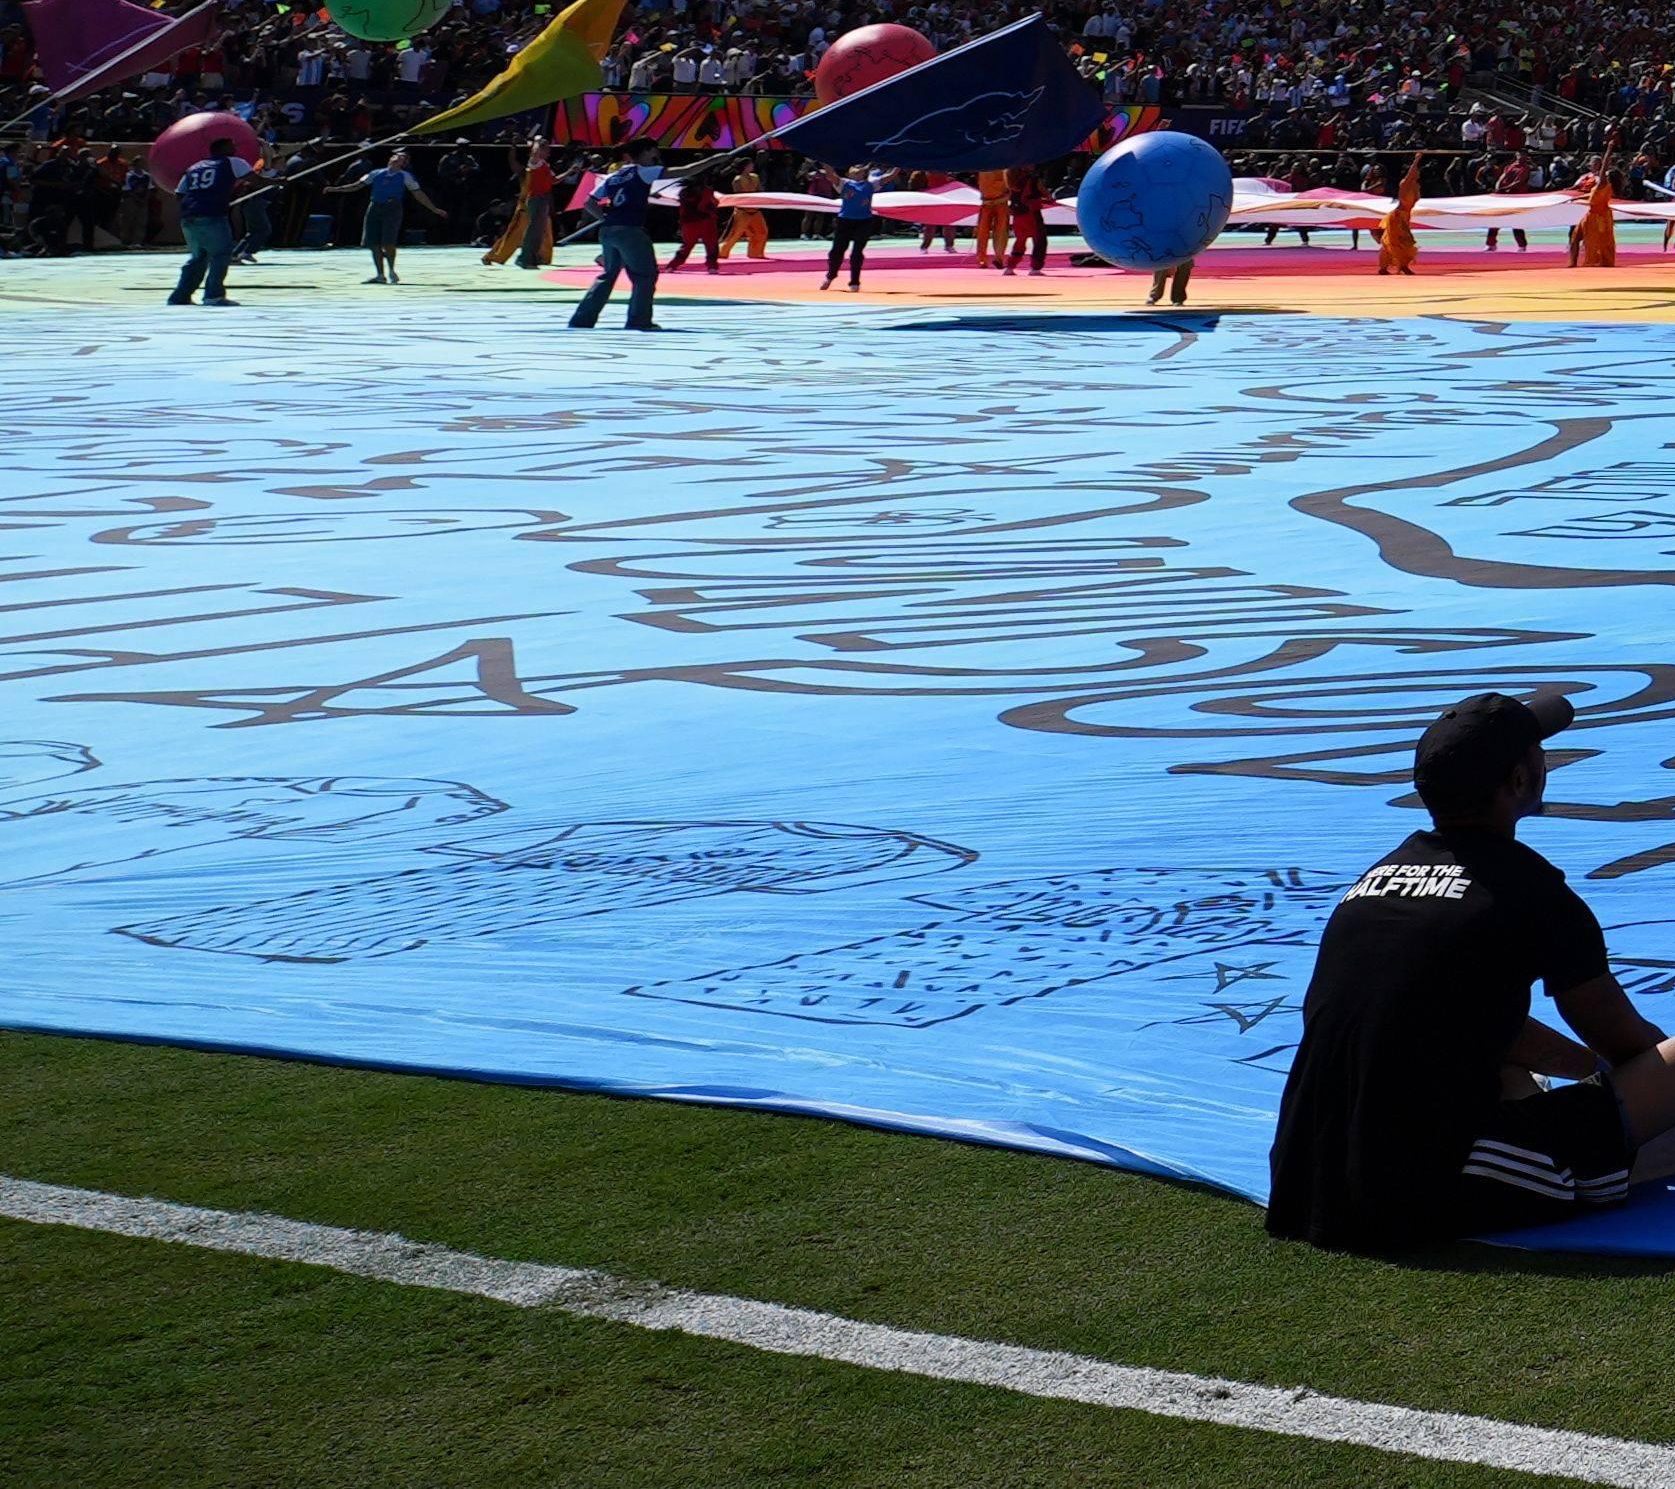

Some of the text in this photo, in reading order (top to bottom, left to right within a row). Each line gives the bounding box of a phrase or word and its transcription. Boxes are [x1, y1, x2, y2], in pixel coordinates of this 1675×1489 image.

[189, 168, 216, 191] 19
[1397, 865, 1430, 878] FOR
[1431, 865, 1465, 877] THE
